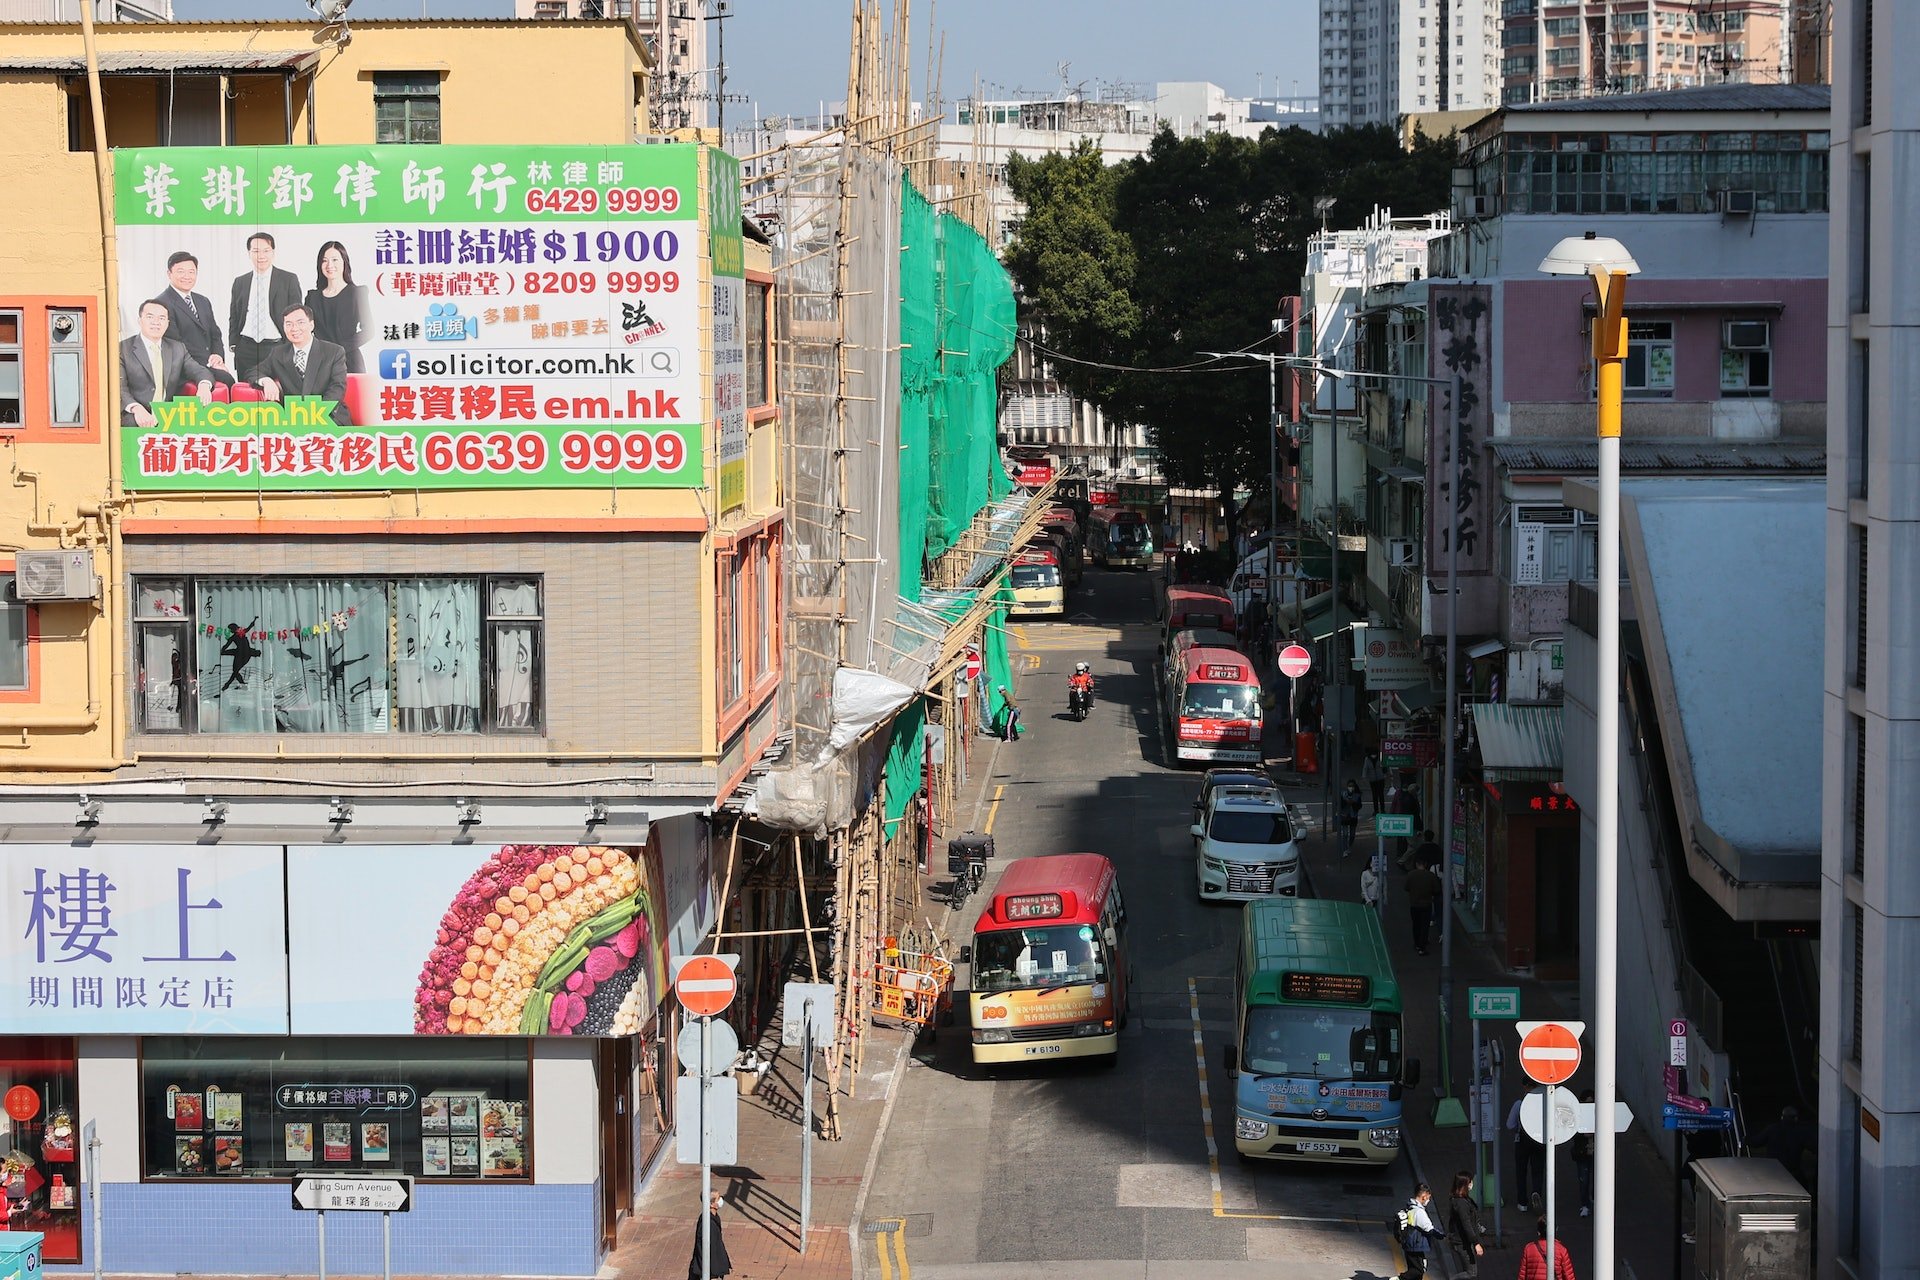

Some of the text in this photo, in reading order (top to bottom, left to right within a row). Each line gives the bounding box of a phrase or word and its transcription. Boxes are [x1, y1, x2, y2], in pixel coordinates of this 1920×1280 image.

[527, 160, 624, 187] 林律師
[134, 160, 518, 219] 葉謝鄧律師行
[527, 187, 681, 214] 6429 9999
[523, 272, 597, 296] 8209
[607, 272, 681, 295] 9999
[383, 319, 465, 341] 法律 視頻
[416, 353, 635, 377] solicitor.com.hk
[423, 431, 546, 473] 6639
[558, 431, 687, 473] 9999
[1384, 742, 1413, 751] BCOS
[22, 866, 237, 965] 樓上
[1055, 953, 1064, 961] 17
[27, 975, 236, 1010] 期間限定店
[1039, 1045, 1061, 1054] 6130
[1673, 1039, 1685, 1063] 上水
[1299, 1142, 1338, 1152] YF 5537
[309, 1182, 392, 1193] Lung Sum Avenue
[331, 1196, 370, 1207] 龍琛路
